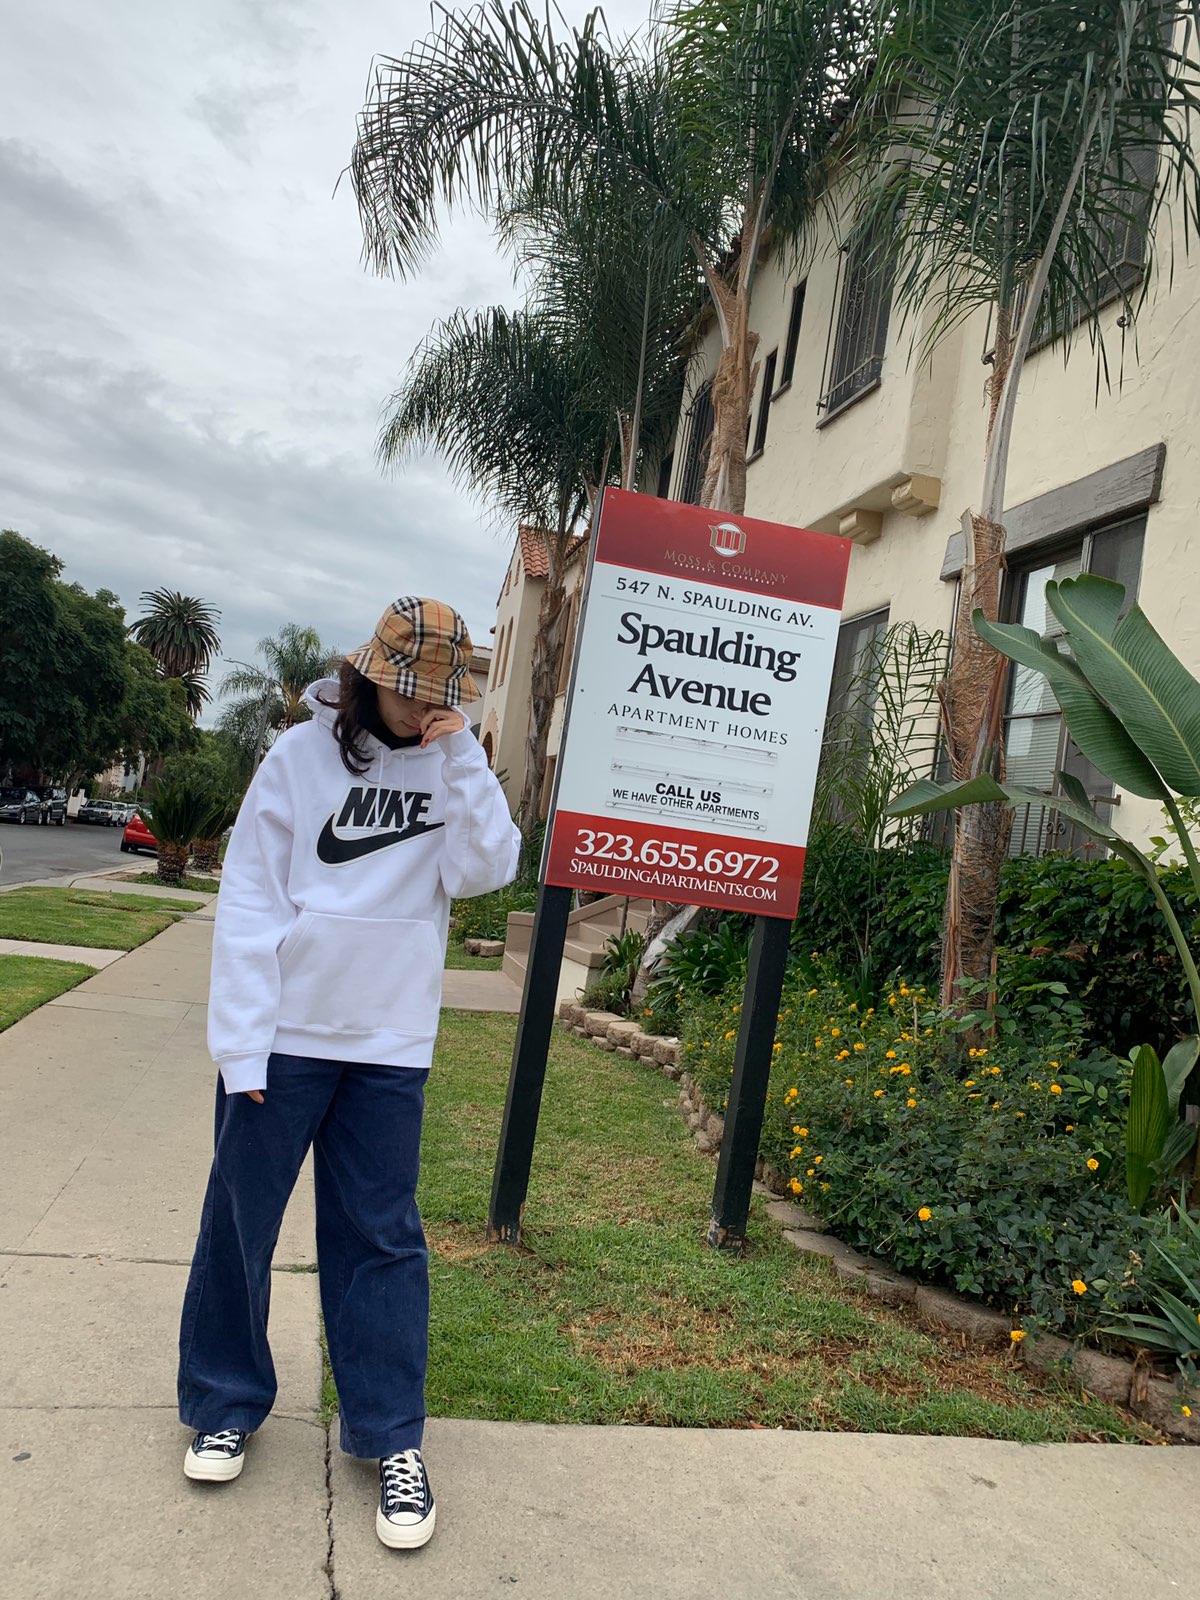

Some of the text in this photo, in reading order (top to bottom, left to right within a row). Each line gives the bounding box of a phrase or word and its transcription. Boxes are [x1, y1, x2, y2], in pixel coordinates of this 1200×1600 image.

[664, 549, 701, 566] MOSS
[706, 560, 716, 569] &
[721, 561, 788, 584] COMPANY
[617, 577, 815, 628] 547 N. SPAULDING AV.
[617, 612, 801, 683] Spaulding
[627, 663, 772, 716] Avenue
[607, 703, 789, 746] APARTMENT HOMES
[335, 786, 433, 829] NIKE
[612, 788, 760, 821] WE HAVE OTHER APARTMENTS
[655, 783, 722, 804] CALL US
[574, 828, 780, 884] 323.655.6972
[569, 858, 778, 901] SPAULDINGAPARTMENTS.COM
